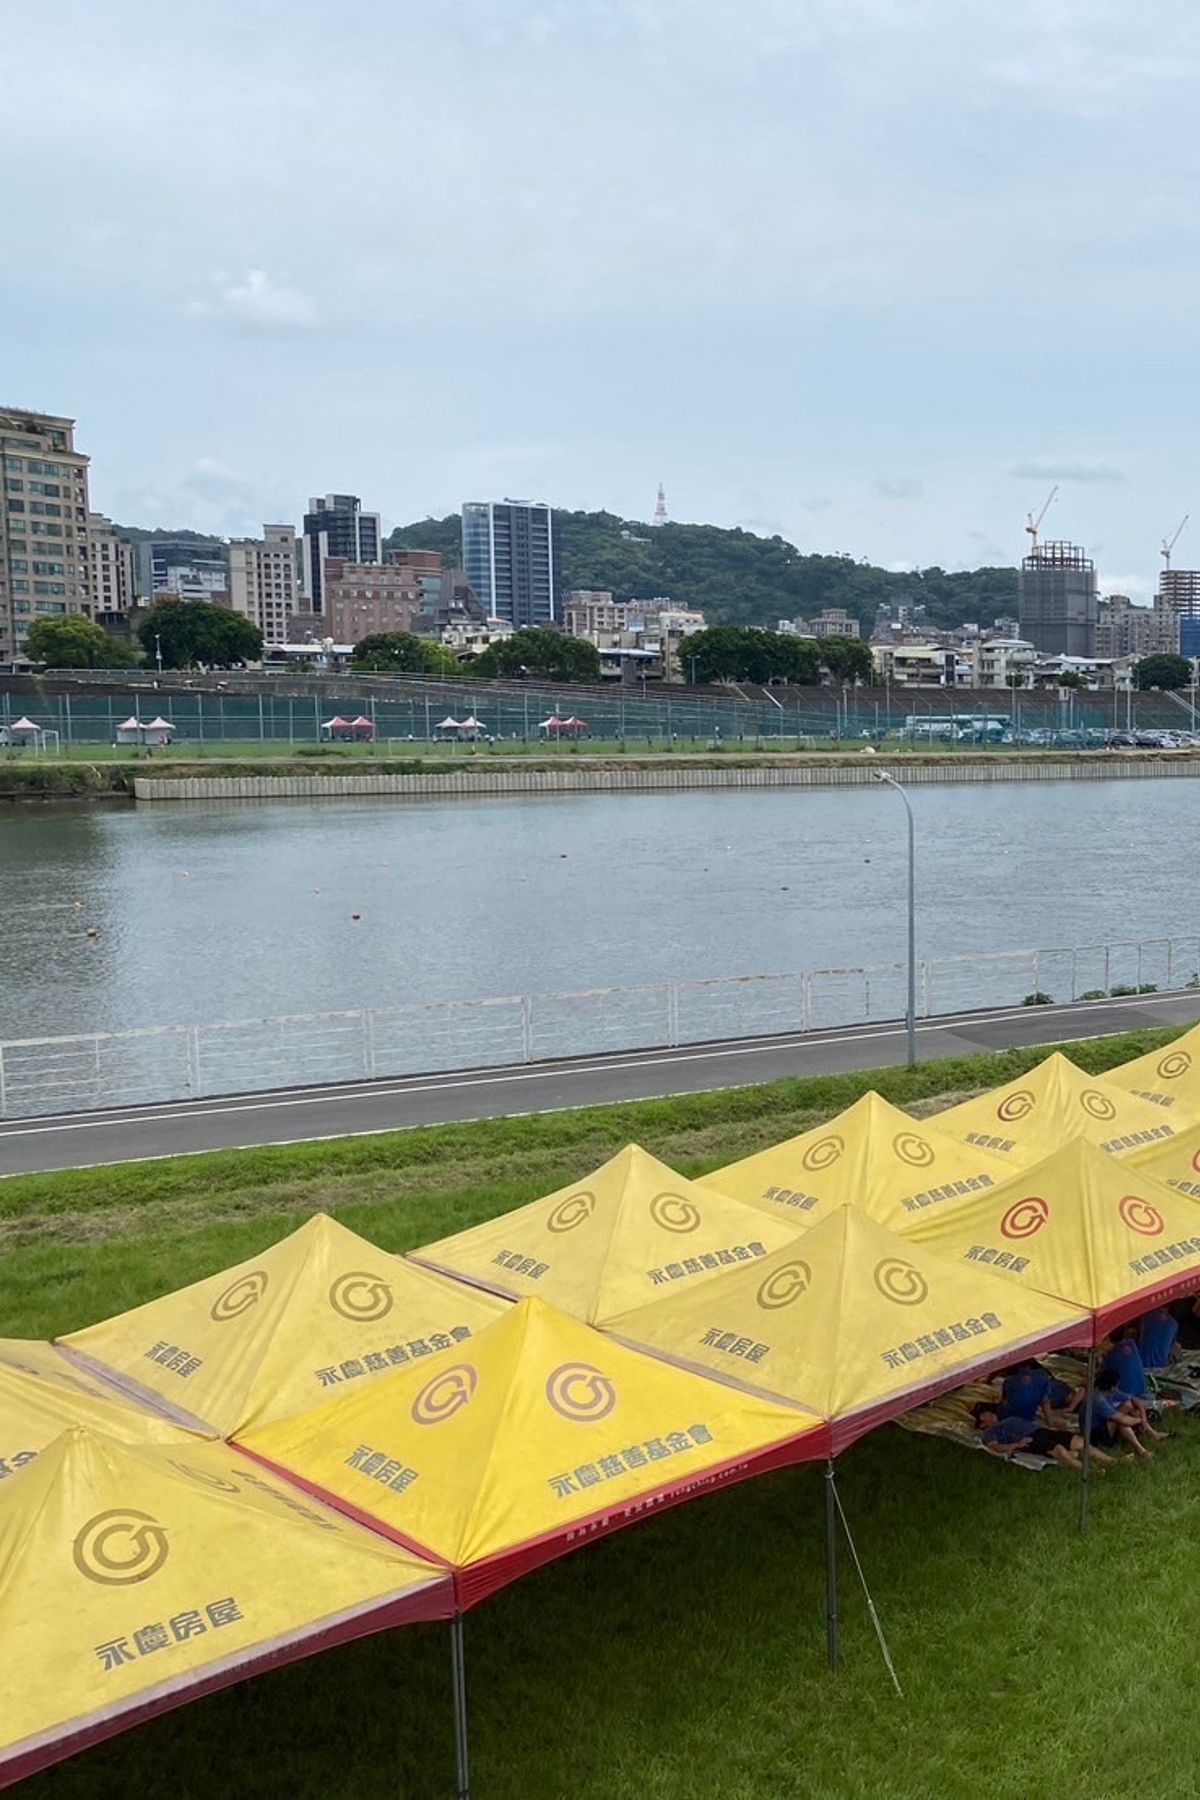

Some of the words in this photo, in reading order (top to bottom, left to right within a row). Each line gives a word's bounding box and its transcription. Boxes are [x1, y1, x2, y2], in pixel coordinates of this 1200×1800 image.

[491, 1249, 550, 1279] 永慶房屋
[647, 1241, 768, 1286] 永慶慈善基金會
[144, 1341, 204, 1379] 永慶房屋
[315, 1325, 473, 1388] 永慶慈善基金會
[700, 1326, 770, 1364] 永慶房屋
[880, 1311, 1003, 1370] 永慶慈善基金會
[344, 1444, 419, 1495] 永慶房屋
[547, 1423, 715, 1498] 永慶慈善基金會
[95, 1597, 246, 1671] 永慶房屋
